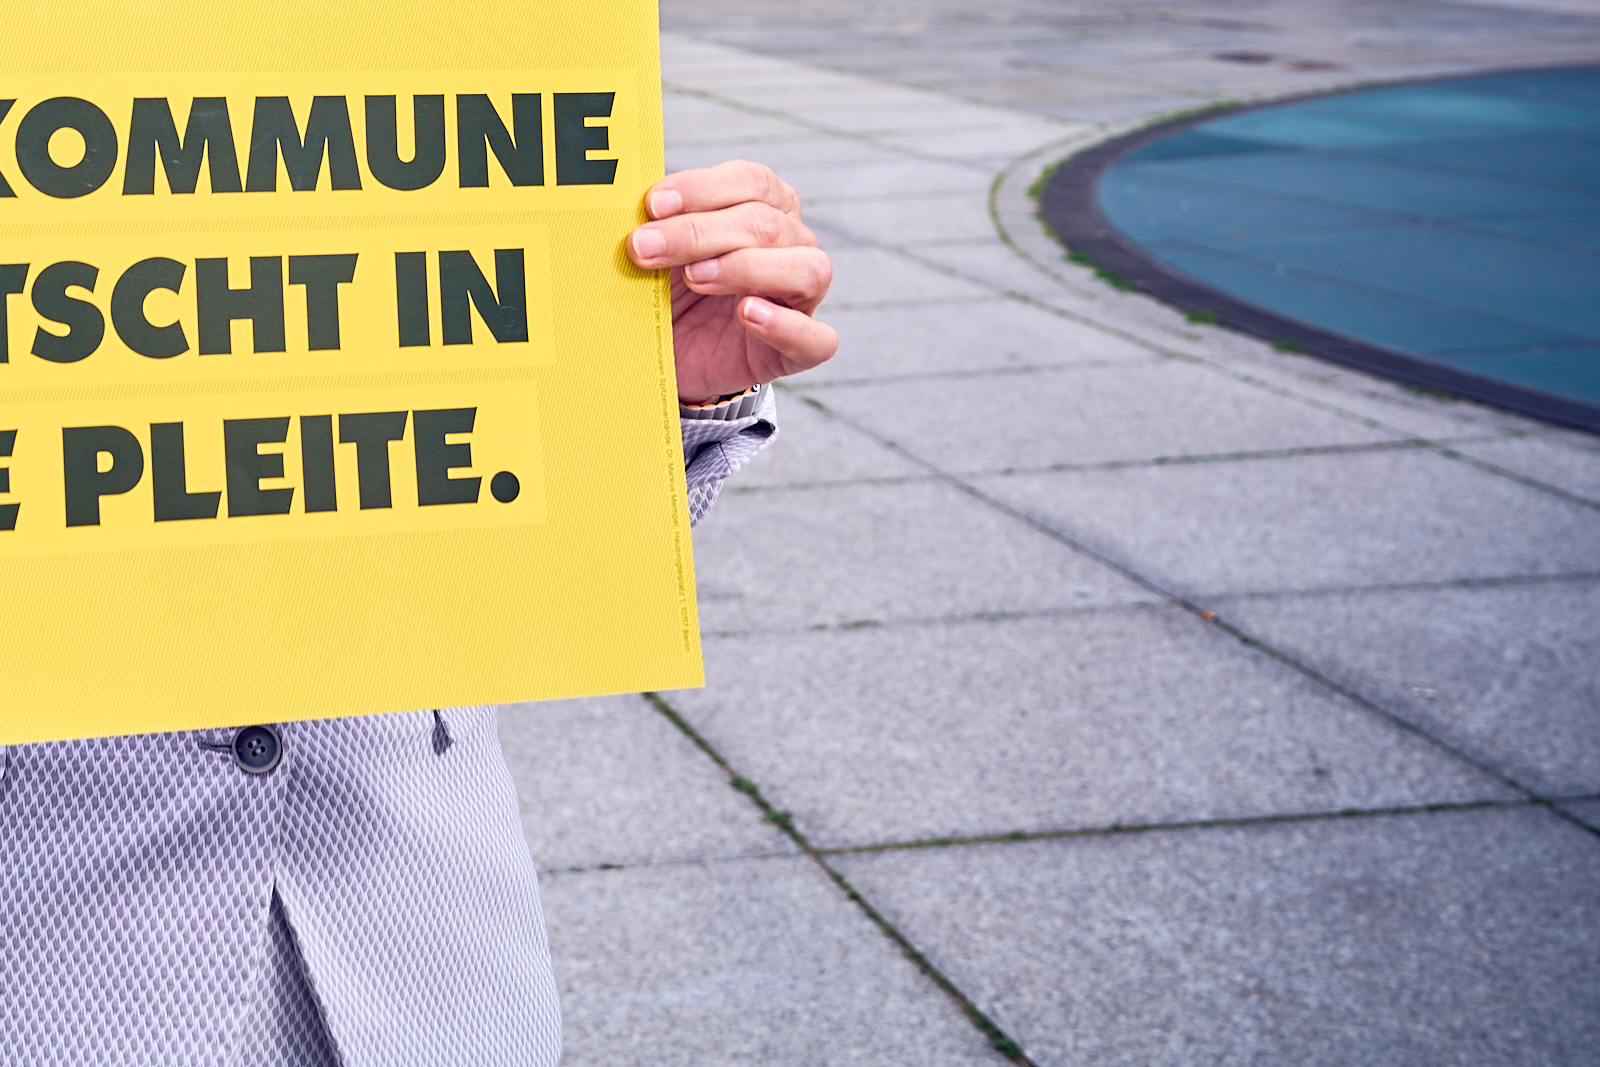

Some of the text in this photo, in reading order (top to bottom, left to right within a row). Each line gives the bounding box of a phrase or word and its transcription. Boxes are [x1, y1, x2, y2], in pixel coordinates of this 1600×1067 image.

[394, 247, 530, 348] IN
[654, 310, 663, 324] der
[655, 325, 667, 376] kommunalen
[61, 406, 521, 528] PLEITE.
[668, 462, 677, 493] Markus
[674, 531, 686, 596] Hausvogteiplatz
[682, 628, 692, 653] Berlin
